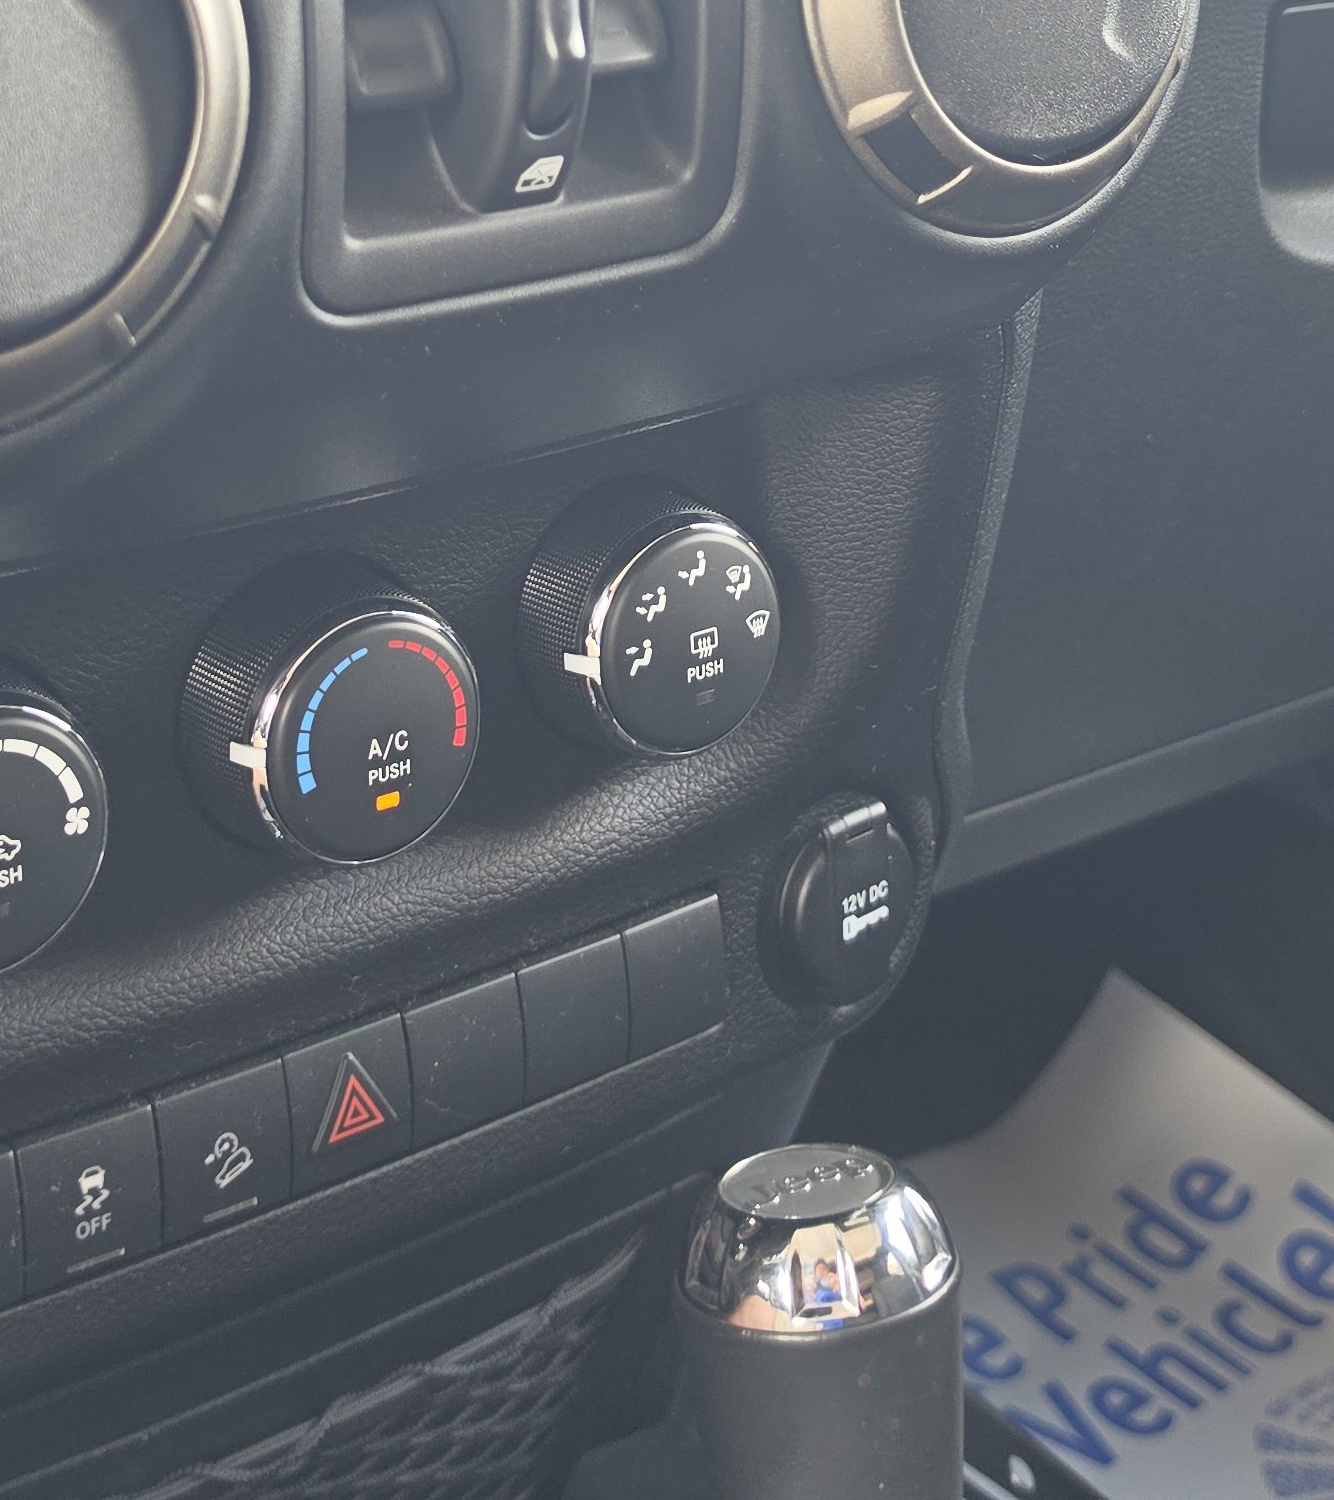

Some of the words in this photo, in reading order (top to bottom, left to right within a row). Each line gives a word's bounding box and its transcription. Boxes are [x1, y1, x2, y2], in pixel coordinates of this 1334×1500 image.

[687, 657, 724, 683] PUSH
[368, 729, 410, 761] A/C
[368, 758, 411, 787] PUSH
[841, 889, 867, 914] 12V
[869, 879, 889, 903] DC
[74, 1210, 113, 1240] OFF
[990, 1156, 1256, 1345] Pride
